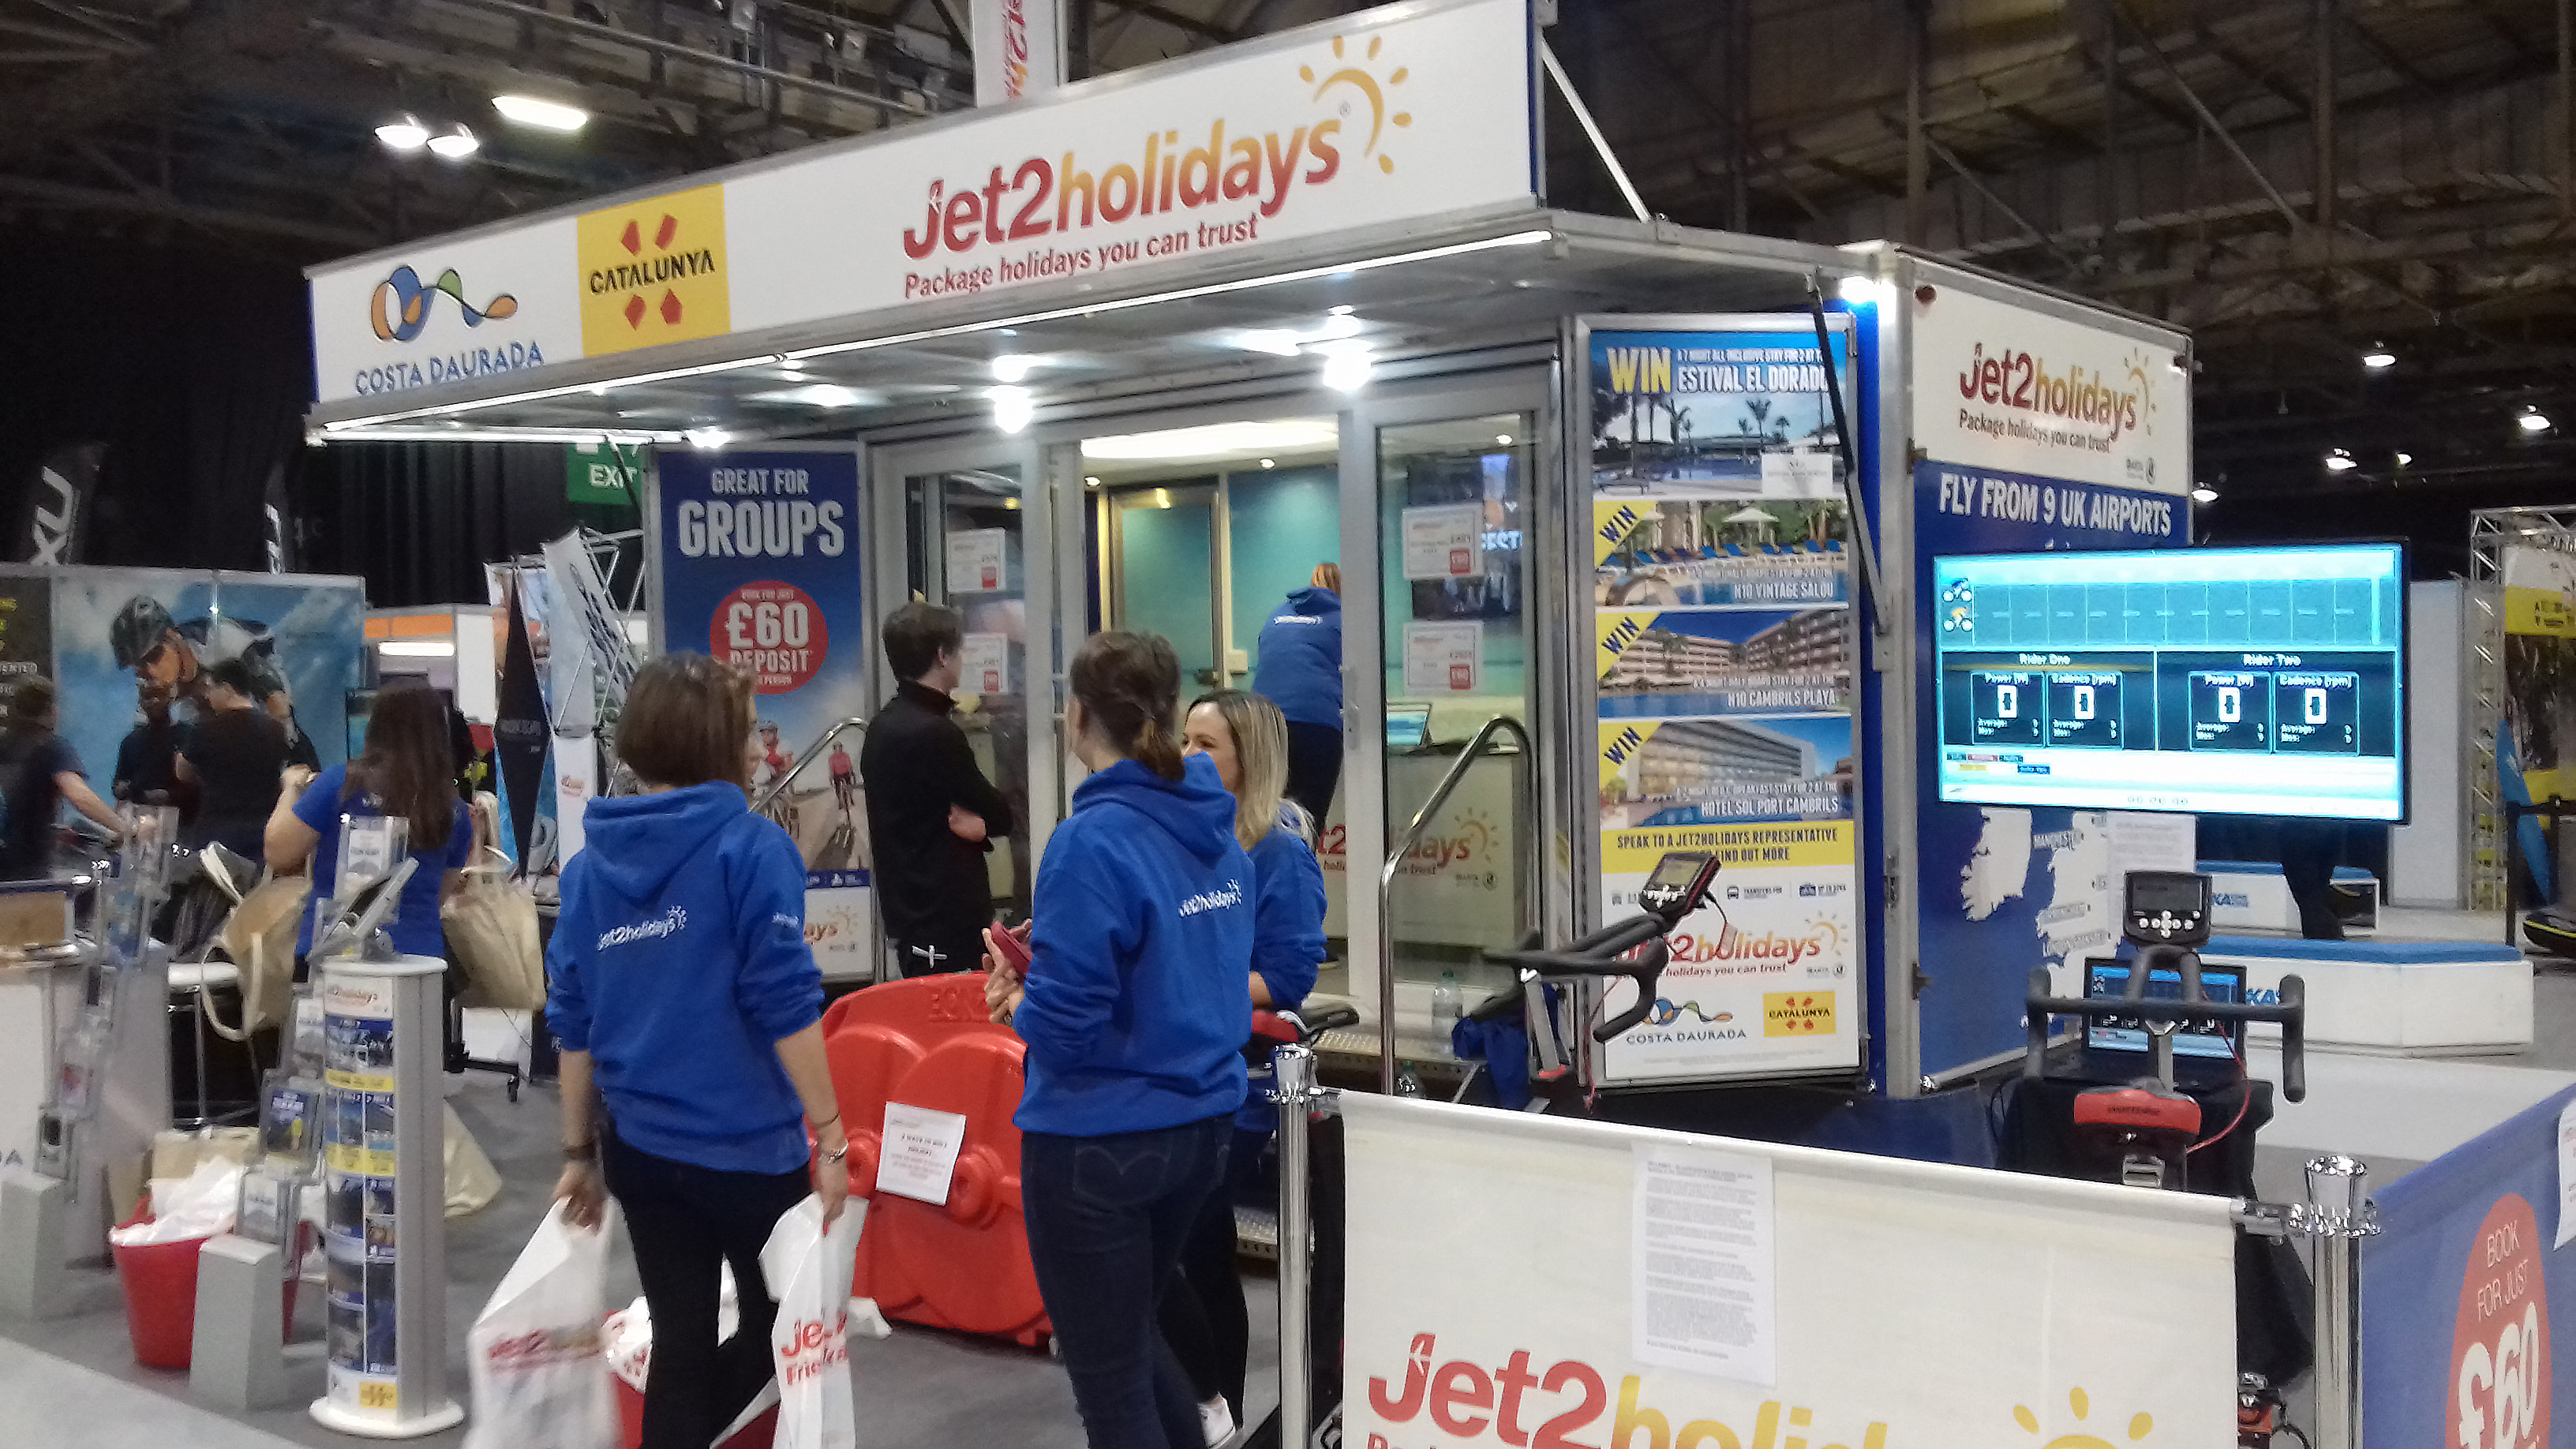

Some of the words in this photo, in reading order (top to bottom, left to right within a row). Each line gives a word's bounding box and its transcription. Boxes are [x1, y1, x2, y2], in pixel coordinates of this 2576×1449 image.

[904, 118, 1340, 260] Jet2holidays
[590, 249, 715, 295] CATALUNYA
[904, 265, 993, 299] Package
[1000, 245, 1091, 283] holidays
[1098, 239, 1139, 271] you
[1147, 230, 1189, 259] can
[1197, 212, 1259, 248] trust
[355, 363, 423, 395] COSTA
[430, 341, 545, 384] DAURADA
[1607, 346, 1672, 394] WIN
[1678, 365, 1744, 393] ESTIVAL
[1746, 365, 1766, 393] EL
[1959, 342, 2137, 443] Jet2holidays
[1959, 407, 2005, 440] Package
[2008, 417, 2048, 446] holidays
[2050, 430, 2067, 447] you
[2069, 433, 2087, 449] can
[2088, 434, 2110, 454] trust
[711, 468, 769, 496] GREAT
[773, 469, 810, 496] FOR
[1940, 472, 1978, 516] FLY
[1980, 477, 2039, 523] FROM
[2042, 486, 2057, 525] 9
[2061, 489, 2087, 529] UK
[2091, 494, 2171, 537] AIRPORTS
[679, 500, 845, 558] GROUPS
[1599, 505, 1638, 543] WIN
[1755, 582, 1798, 599] VINTAGE
[1800, 580, 1833, 599] SALOU
[724, 601, 810, 649] £60
[1602, 615, 1641, 655] WIN
[2019, 653, 2046, 666] Rider
[2049, 653, 2071, 666] One
[2243, 653, 2275, 667] Rider
[2276, 653, 2302, 667] Two
[1749, 690, 1801, 707] CAMBRILS
[1803, 688, 1837, 706] PLAYA
[1998, 685, 2017, 718] 0
[2074, 685, 2095, 720] 0
[2218, 687, 2241, 723] 0
[2305, 687, 2327, 724] 0
[1603, 726, 1643, 766] WIN
[1702, 799, 1735, 817] HOTEL
[1736, 798, 1755, 816] SOL
[1758, 797, 1784, 815] PORT
[1786, 796, 1838, 814] CAMBRILS
[1617, 835, 1649, 849] SPEAK
[1653, 833, 1664, 848] TO
[1668, 833, 1673, 848] A
[1676, 830, 1750, 848] JET2HOLIDAYS
[1753, 828, 1838, 845] REPRESENTATIVE
[1741, 848, 1759, 862] OUT
[1763, 846, 1790, 861] MORE
[1665, 964, 1711, 978] holidays
[1714, 967, 1732, 978] you
[1760, 963, 1787, 974] trust
[1769, 1007, 1831, 1020] CATALUNYA
[1627, 1032, 1671, 1046] COSTA
[1676, 1028, 1747, 1043] DAURADA
[2487, 1219, 2520, 1269] BOOK
[2477, 1278, 2503, 1324] FOR
[2505, 1259, 2529, 1306] JUST
[2458, 1301, 2540, 1449] £60
